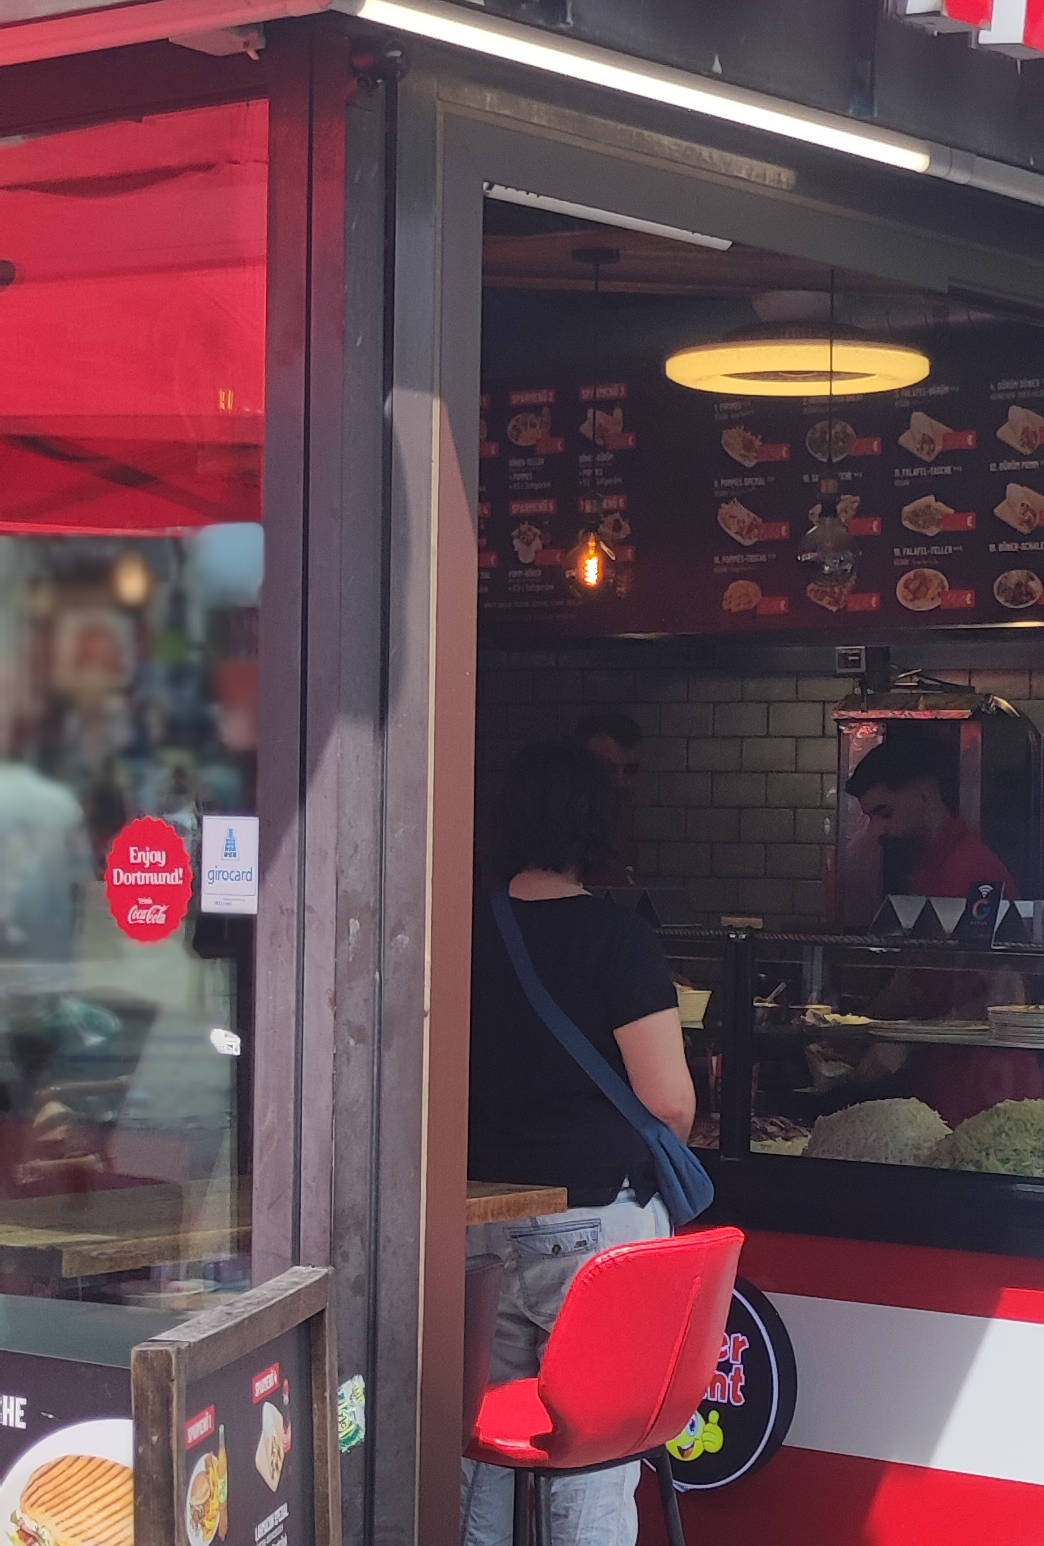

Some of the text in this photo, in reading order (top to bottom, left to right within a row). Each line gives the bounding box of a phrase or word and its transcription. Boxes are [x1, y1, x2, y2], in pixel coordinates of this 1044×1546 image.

[129, 846, 167, 868] Enjoy
[112, 867, 184, 886] Dortmund!
[207, 865, 253, 885] girocard
